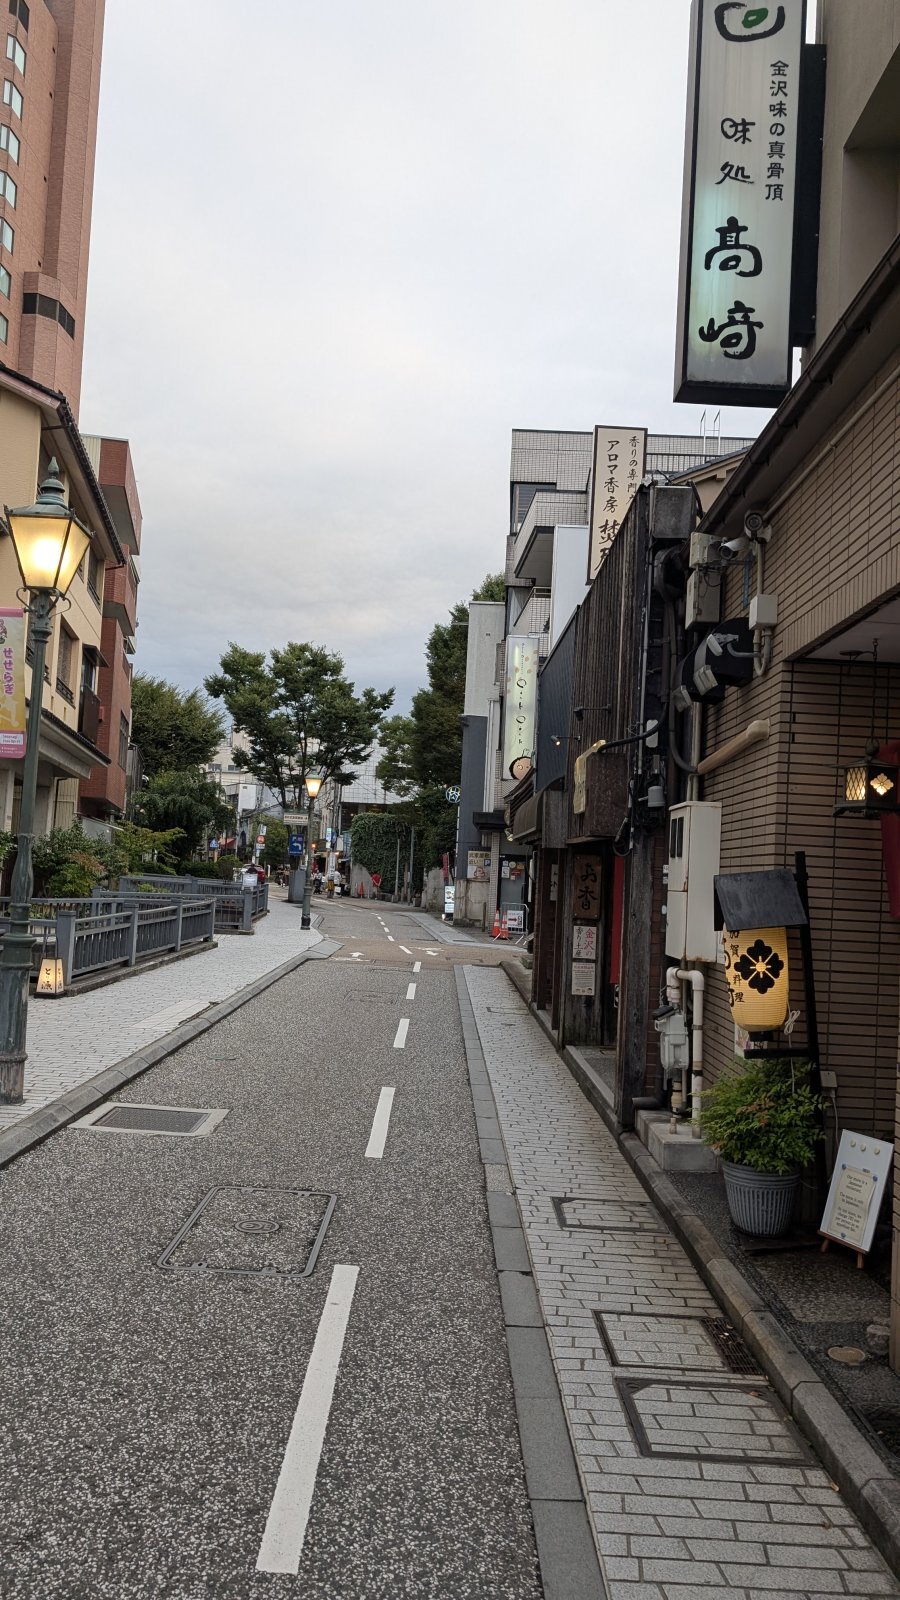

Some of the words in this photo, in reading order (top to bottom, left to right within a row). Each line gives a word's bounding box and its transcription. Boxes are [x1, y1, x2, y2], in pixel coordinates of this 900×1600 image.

[715, 117, 756, 185] 味処
[765, 60, 789, 201] 金沢味の真骨頂
[3, 647, 14, 695] せせらぎ
[577, 863, 597, 911] お香
[583, 927, 595, 957] 金沢の
